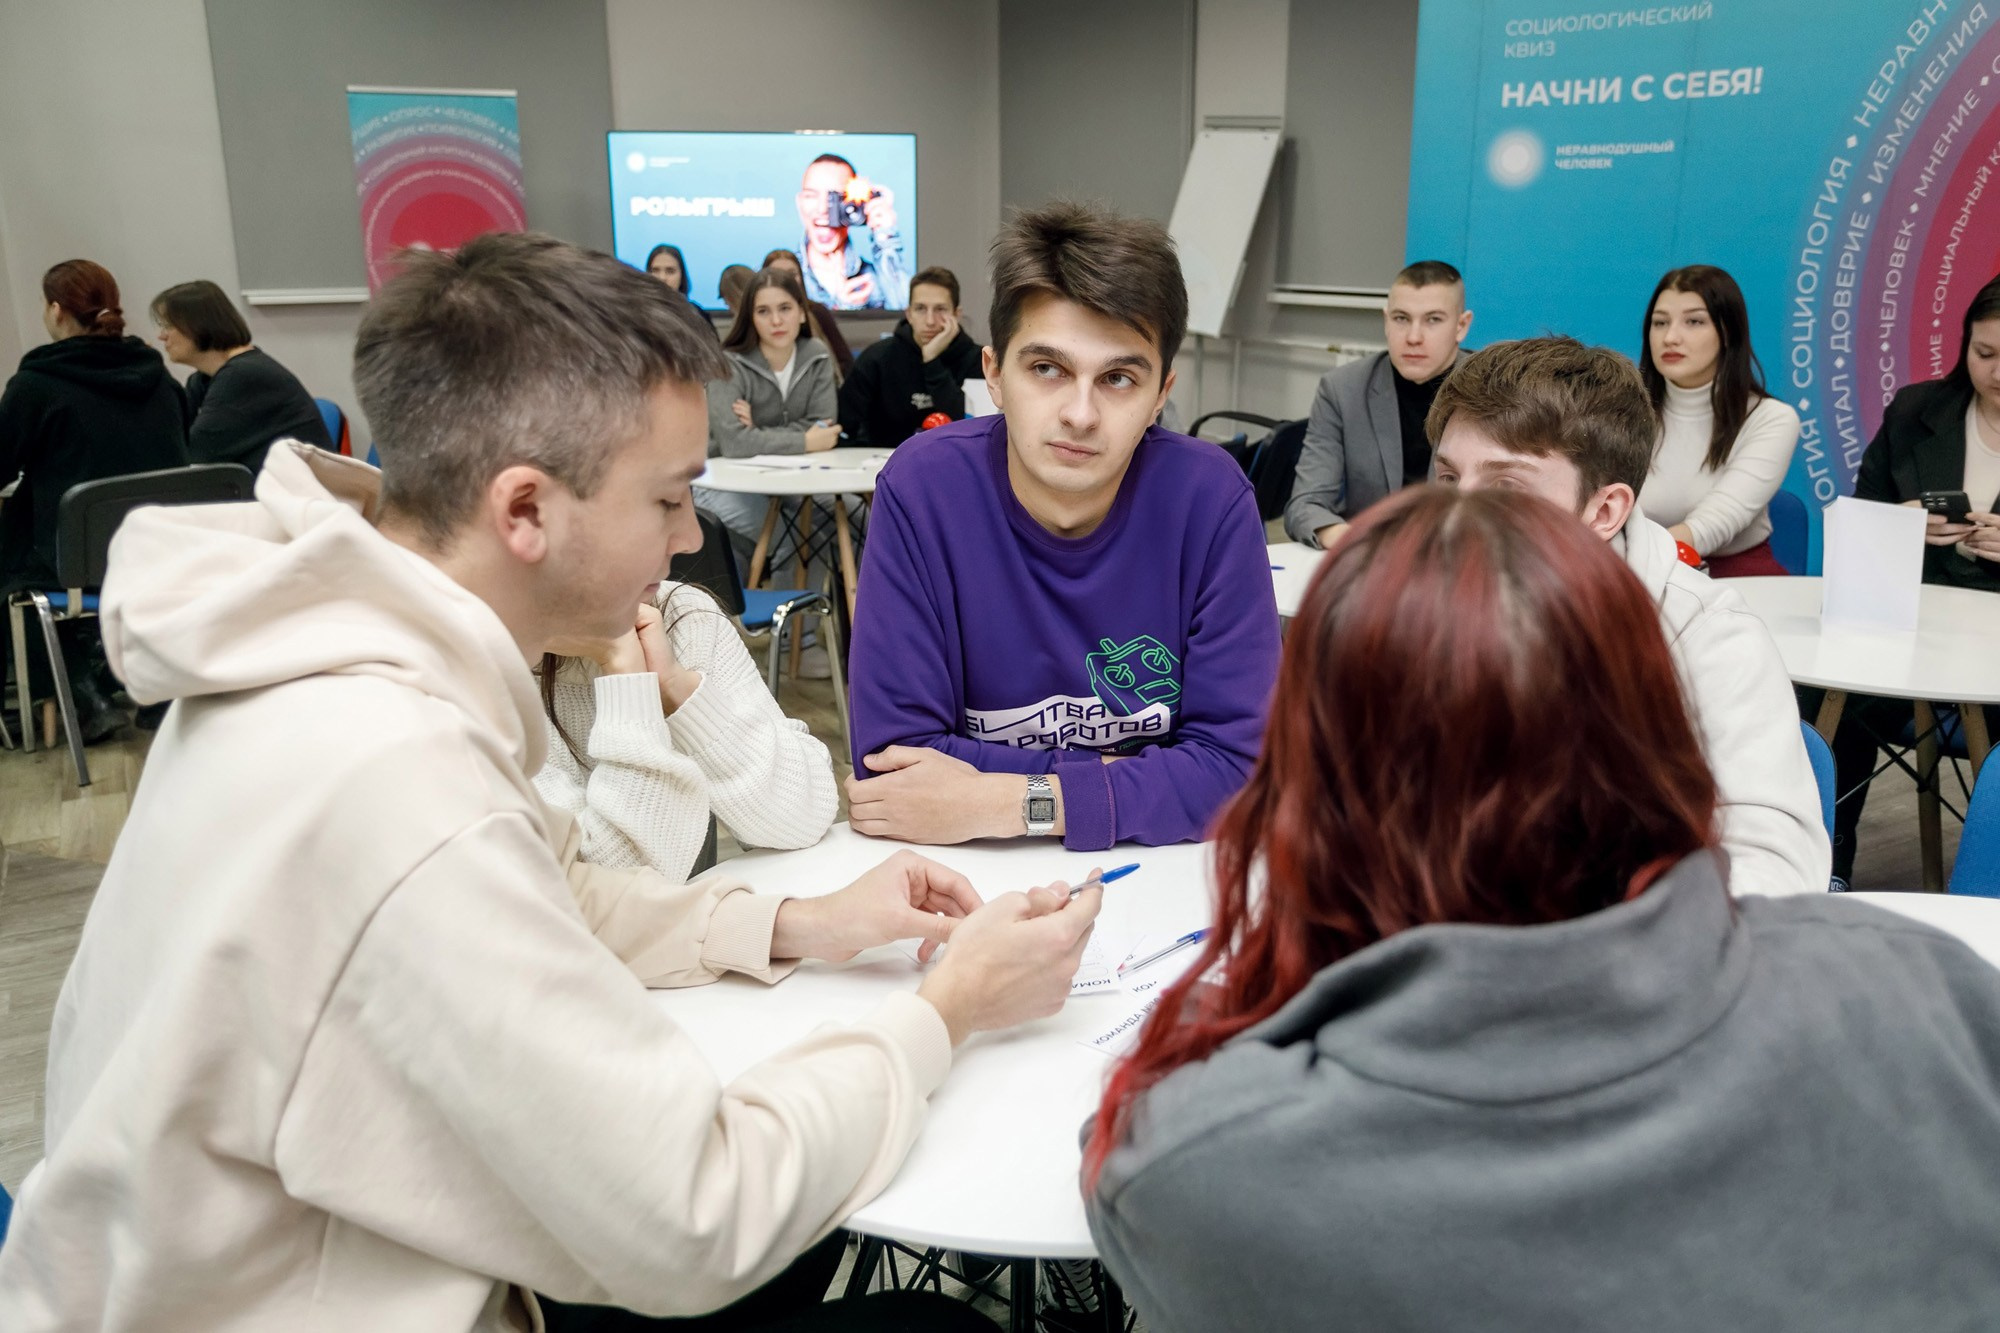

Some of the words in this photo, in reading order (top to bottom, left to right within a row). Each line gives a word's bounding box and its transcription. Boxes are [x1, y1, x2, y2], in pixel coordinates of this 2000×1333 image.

[1505, 2, 1713, 37] СОЦИОЛОГИЧЕСКИЙ
[1504, 41, 1556, 58] КВИЗ
[1501, 76, 1622, 108] НАЧНИ
[1631, 74, 1654, 102] С
[1662, 67, 1764, 100] СЕБЯ!
[1867, 2, 1988, 184] ИЗМЕНЕНИЯ
[1555, 158, 1613, 170] ЧЕЛОВЕК
[1556, 140, 1674, 156] НЕРАВНОДУШНЫЙ
[1879, 219, 1915, 339] ЧЕЛОВЕК
[1913, 89, 1980, 197] МНЕНИЕ
[1932, 165, 1992, 315] СОЦИАЛЬНЫЙ
[1791, 156, 1852, 389] СОЦИОЛОГИЯ
[1830, 211, 1871, 353] ДОВЕРИЕ
[1930, 333, 1943, 378] НИЕ
[1831, 374, 1863, 484] ПИТАЛ
[1800, 418, 1837, 511] ОГИЯ
[1017, 713, 1162, 749] РОБОТОВ
[1093, 1013, 1142, 1046] КОМАНДА
